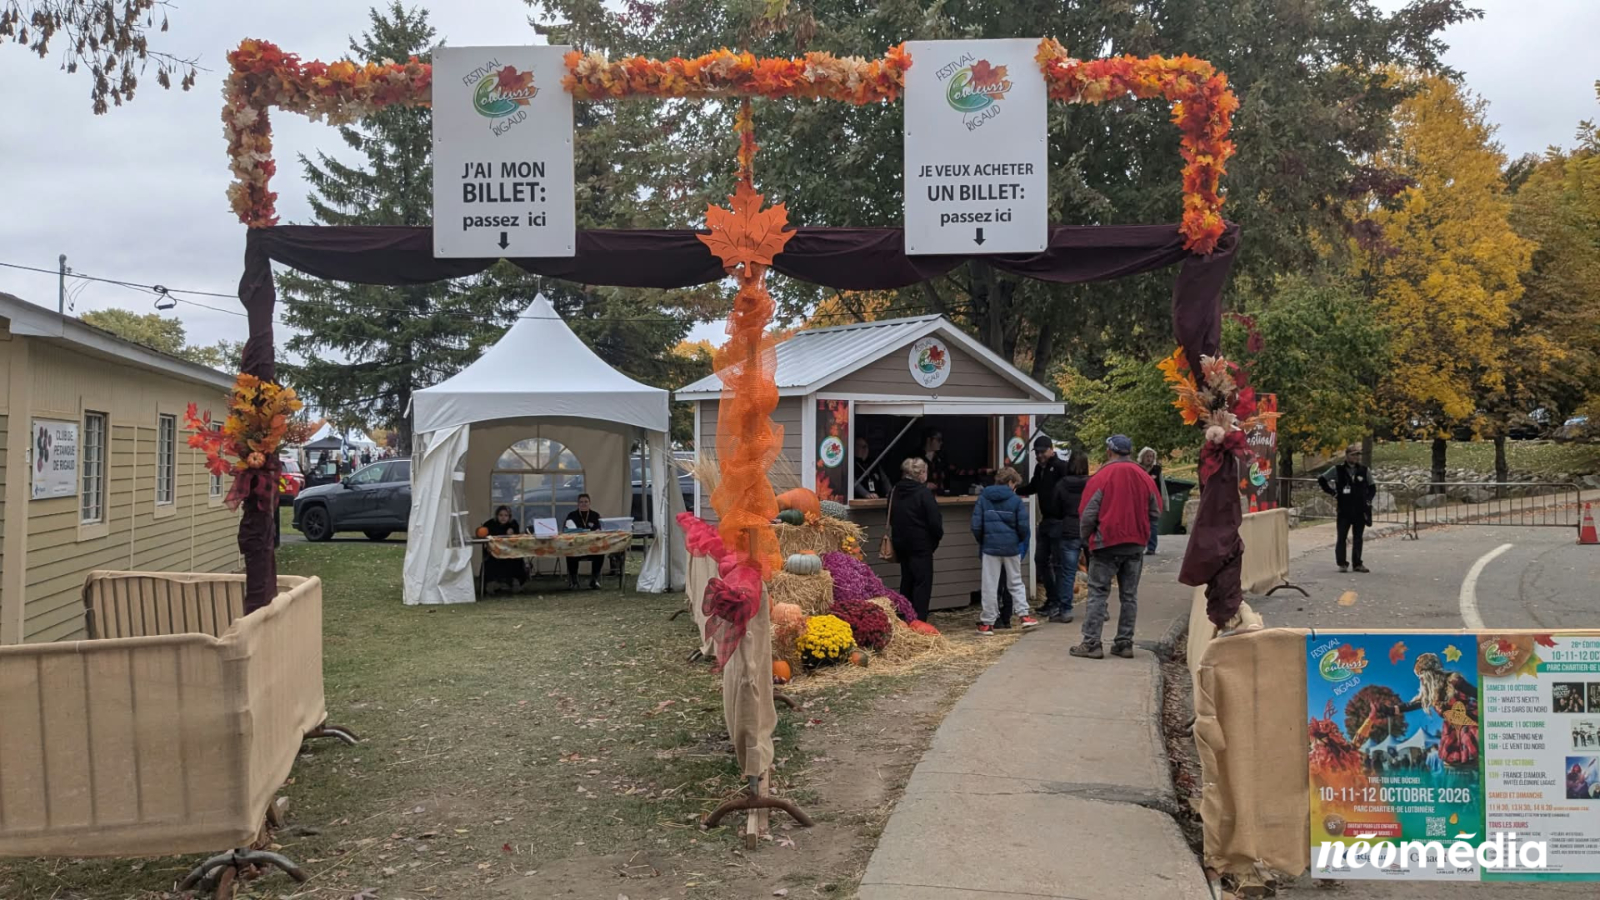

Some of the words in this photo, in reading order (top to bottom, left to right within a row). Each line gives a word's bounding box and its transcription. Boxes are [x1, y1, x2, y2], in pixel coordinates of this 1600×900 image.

[462, 57, 502, 87] FESTIVAL
[935, 52, 975, 81] FESTIVAL
[492, 110, 527, 137] RIGAUD
[965, 104, 1001, 132] RIGAUD
[461, 162, 492, 179] J'AI
[501, 161, 545, 178] MON
[919, 165, 932, 177] JE
[935, 164, 970, 177] VEUX
[974, 163, 1034, 176] ACHETER
[462, 182, 546, 203] BILLET:
[927, 184, 954, 202] UN
[959, 183, 1025, 201] BILLET:
[462, 214, 519, 231] passez
[528, 211, 547, 227] ici
[940, 211, 992, 227] passez
[995, 208, 1012, 222] ici
[55, 429, 66, 441] CLUB
[67, 430, 74, 441] DE
[52, 459, 59, 471] DE
[60, 459, 75, 471] RIGAUD
[1310, 637, 1340, 660] FESTIVAL
[1551, 650, 1588, 661] 10-11-12
[1546, 663, 1561, 672] PARC
[1333, 676, 1361, 696] RIGAUD
[1486, 684, 1506, 692] SAMEDI
[1507, 684, 1513, 692] 10
[1514, 684, 1538, 692] OCTOBRE
[1389, 776, 1401, 784] UNE
[1502, 771, 1522, 779] FRANCE
[1319, 786, 1377, 802] 10-11-12
[1379, 787, 1435, 803] OCTOBRE
[1438, 787, 1470, 803] 2026
[1488, 791, 1508, 799] SAMEDI
[1508, 791, 1515, 799] ET
[1353, 805, 1368, 813] PARC
[1488, 821, 1502, 829] TOUS
[1502, 821, 1512, 829] LES
[1513, 821, 1528, 829] JOURS
